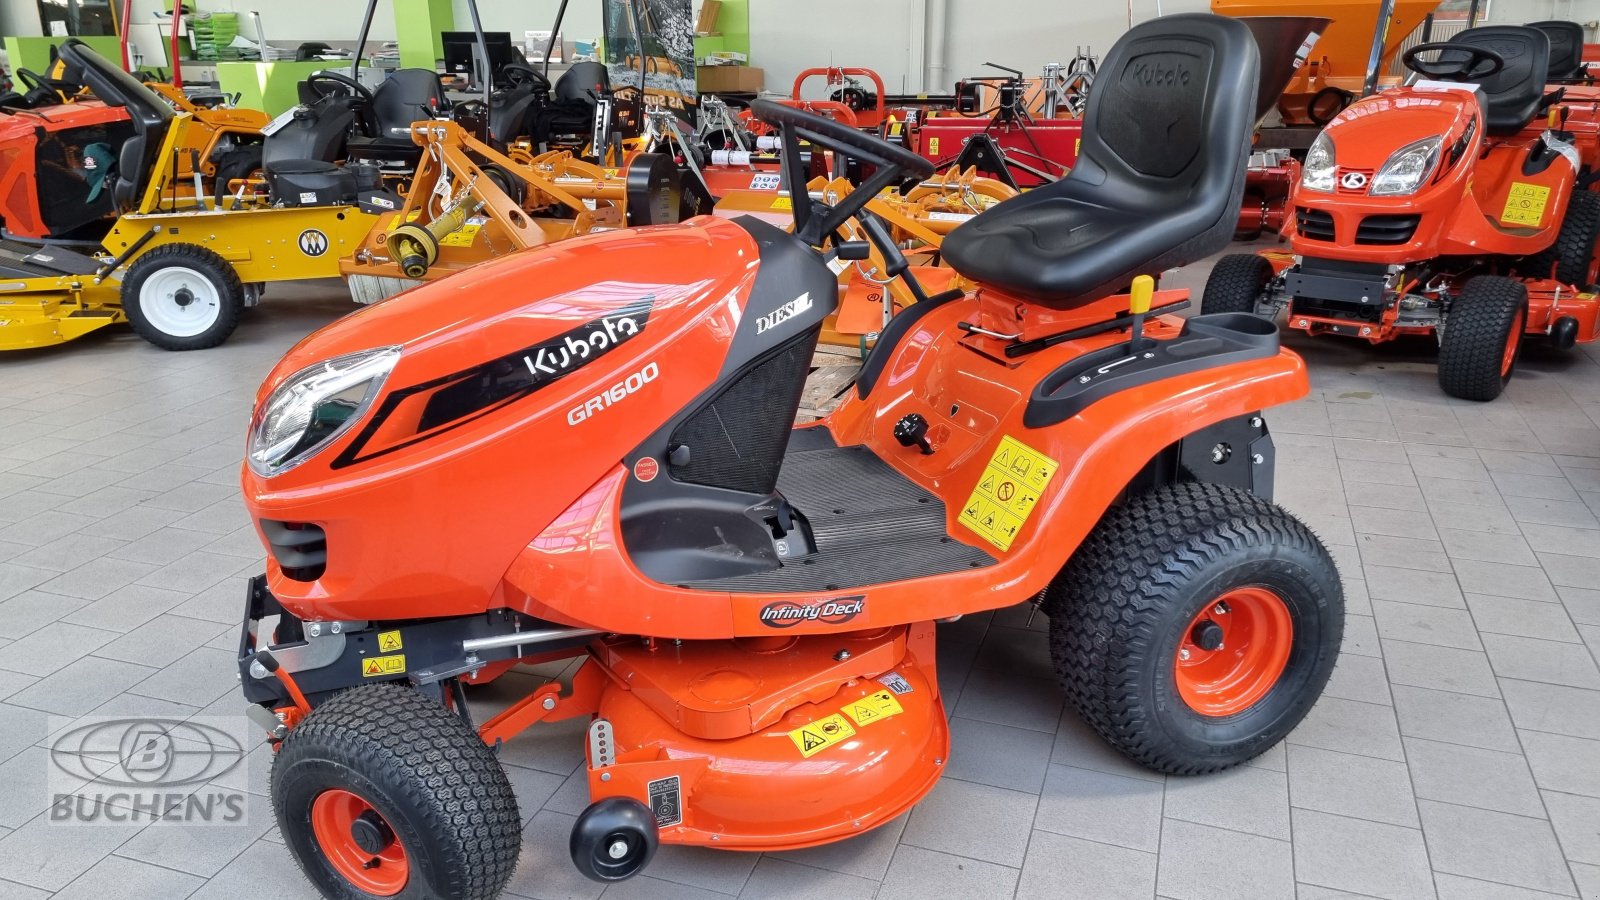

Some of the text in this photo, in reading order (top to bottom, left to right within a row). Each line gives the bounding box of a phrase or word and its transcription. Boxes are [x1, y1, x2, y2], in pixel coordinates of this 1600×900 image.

[1133, 62, 1190, 87] Kubota
[755, 291, 814, 336] DIESEL
[523, 315, 640, 376] Kubota
[567, 361, 660, 426] GR1600
[761, 600, 865, 622] Infinity Deck
